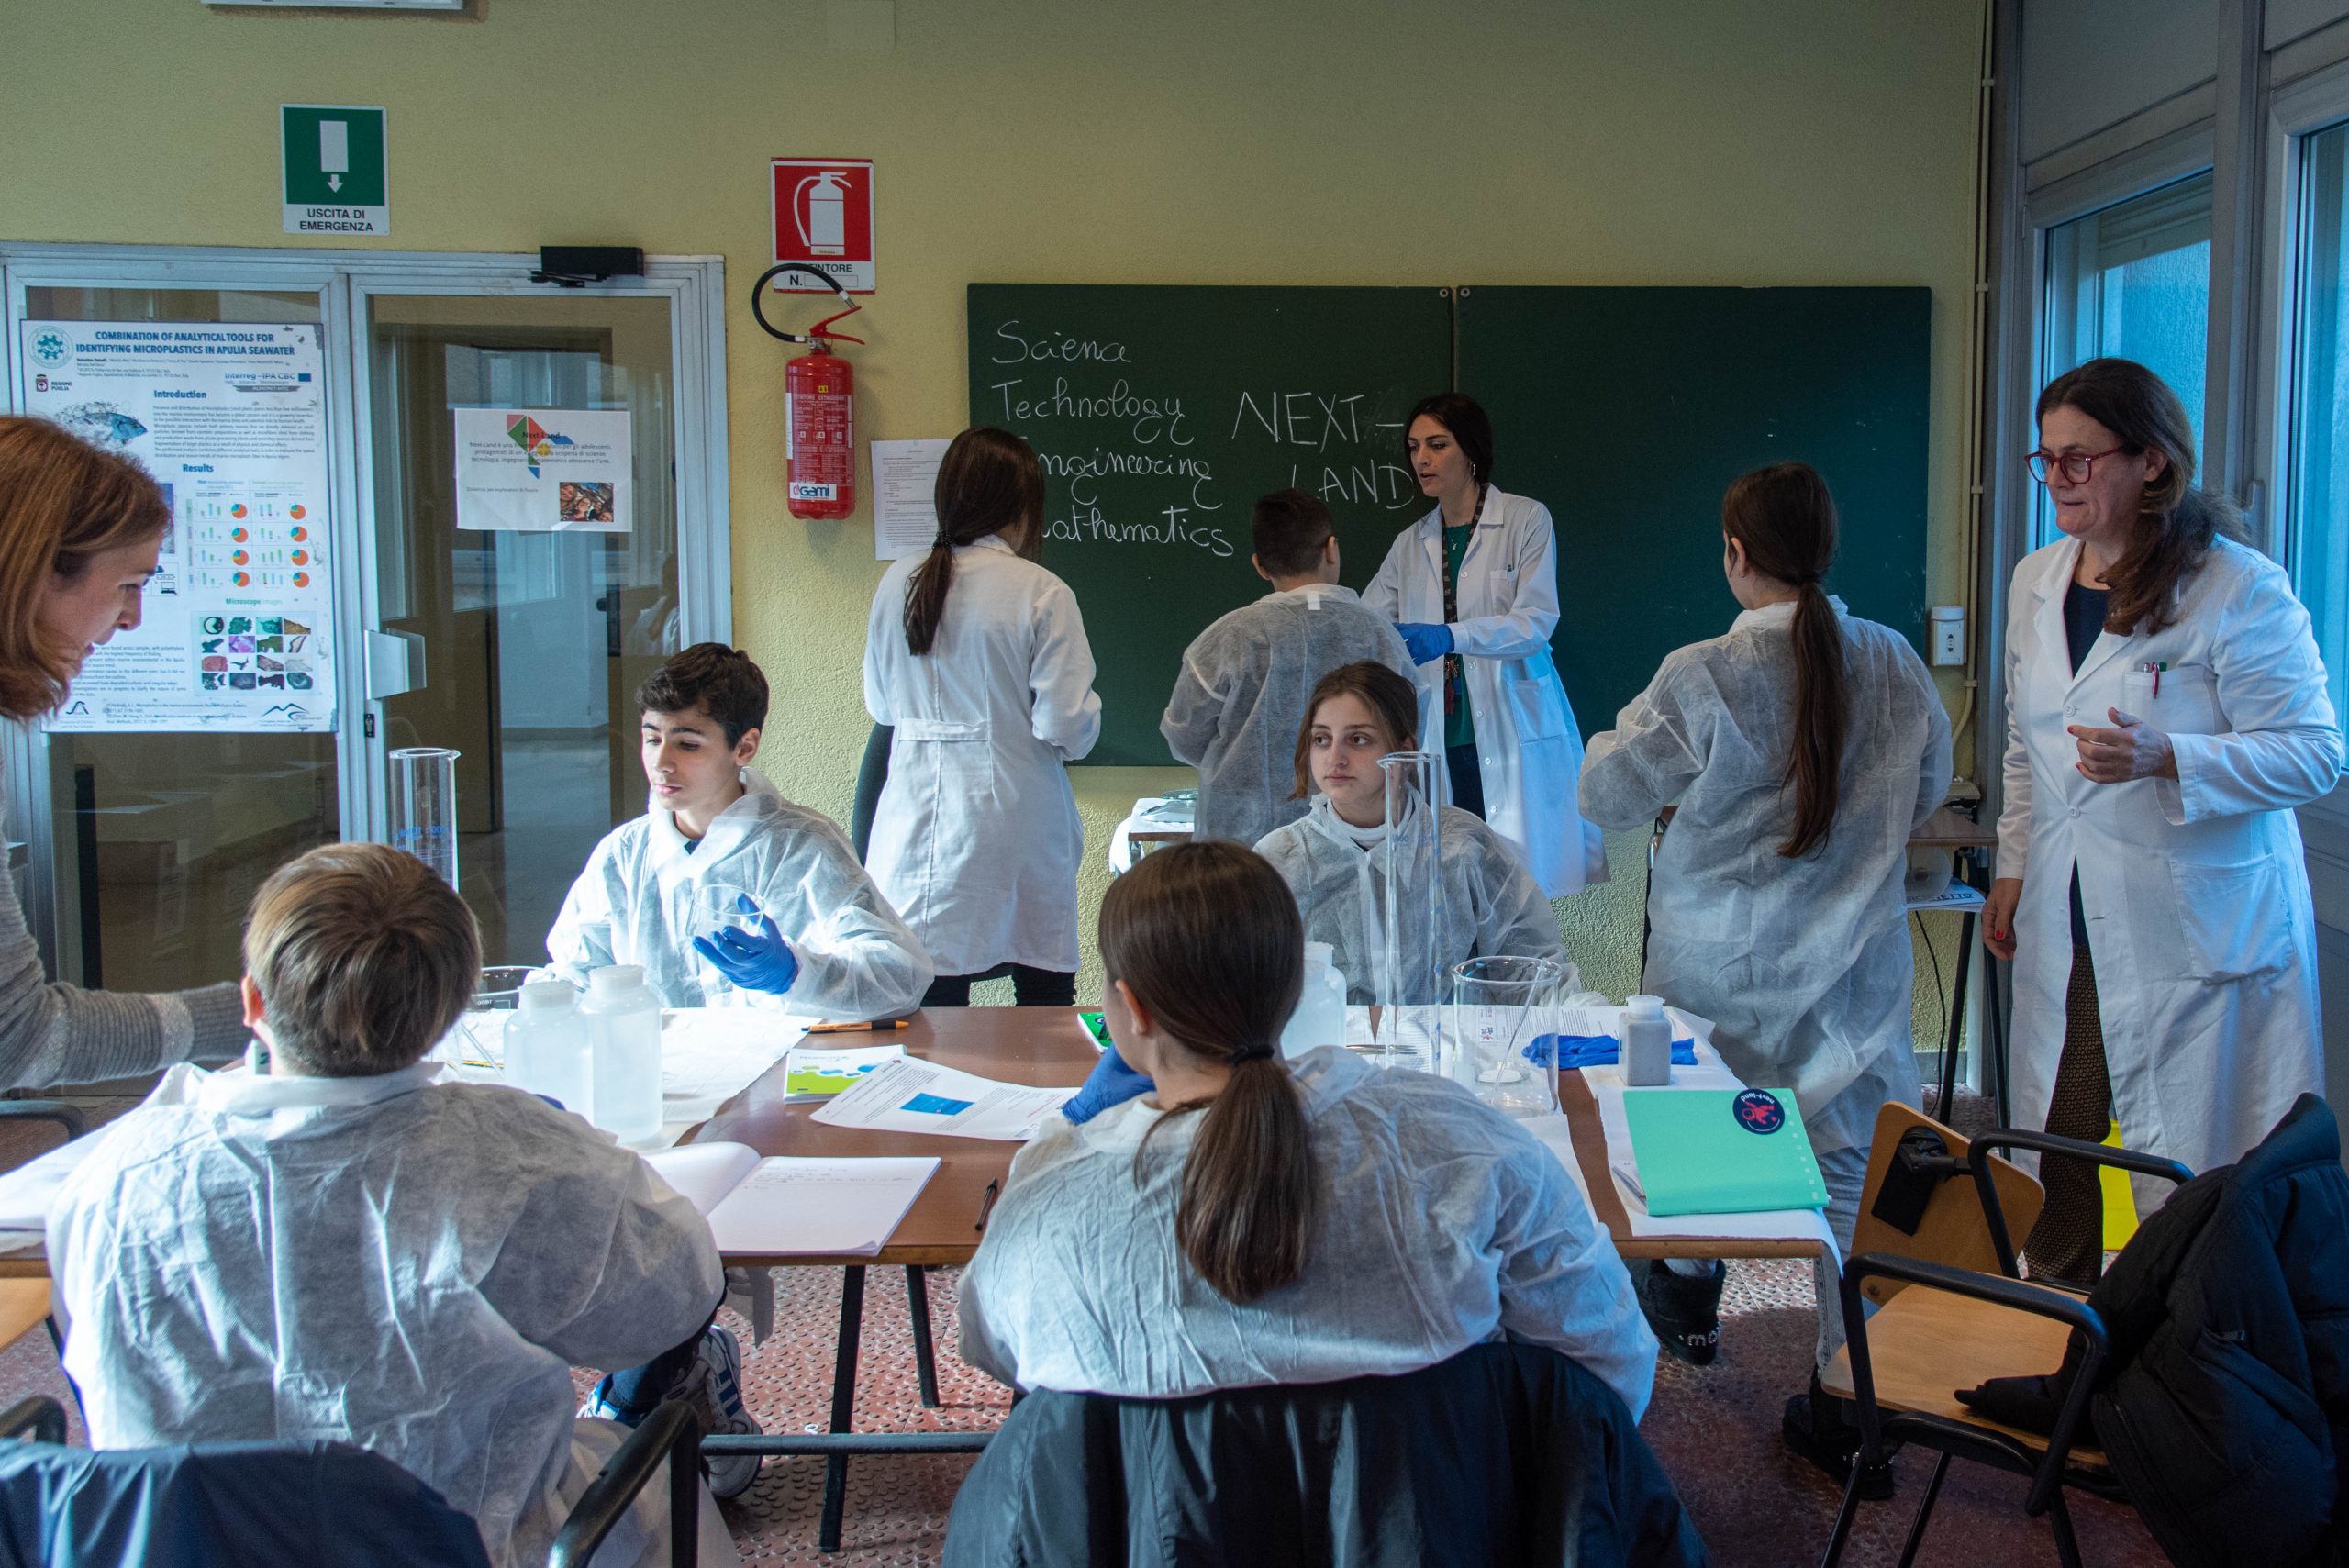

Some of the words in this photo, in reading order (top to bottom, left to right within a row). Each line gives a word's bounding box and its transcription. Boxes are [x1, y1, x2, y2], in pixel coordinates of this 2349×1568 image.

[307, 208, 350, 219] USCITA
[353, 209, 365, 219] DI
[299, 220, 373, 232] EMERGENZA
[808, 263, 852, 272] INTORE
[789, 274, 803, 286] N.
[95, 331, 159, 342] COMBINATION
[161, 331, 173, 342] OF
[174, 332, 227, 342] ANALYTICAL
[227, 332, 252, 343] TOOLS
[255, 333, 274, 343] FOR
[76, 344, 132, 354] IDENTIFYING
[133, 344, 204, 355] MICROPLASTICS
[205, 345, 215, 355] IN
[217, 346, 247, 355] APULIA
[249, 346, 295, 356] SEAWATER
[154, 389, 207, 399] Introduction
[991, 377, 1194, 446] Technology
[183, 463, 214, 473] Results
[1019, 437, 1223, 510] ngineering
[1042, 505, 1234, 556] athematics
[1740, 1092, 1775, 1104] next-land
